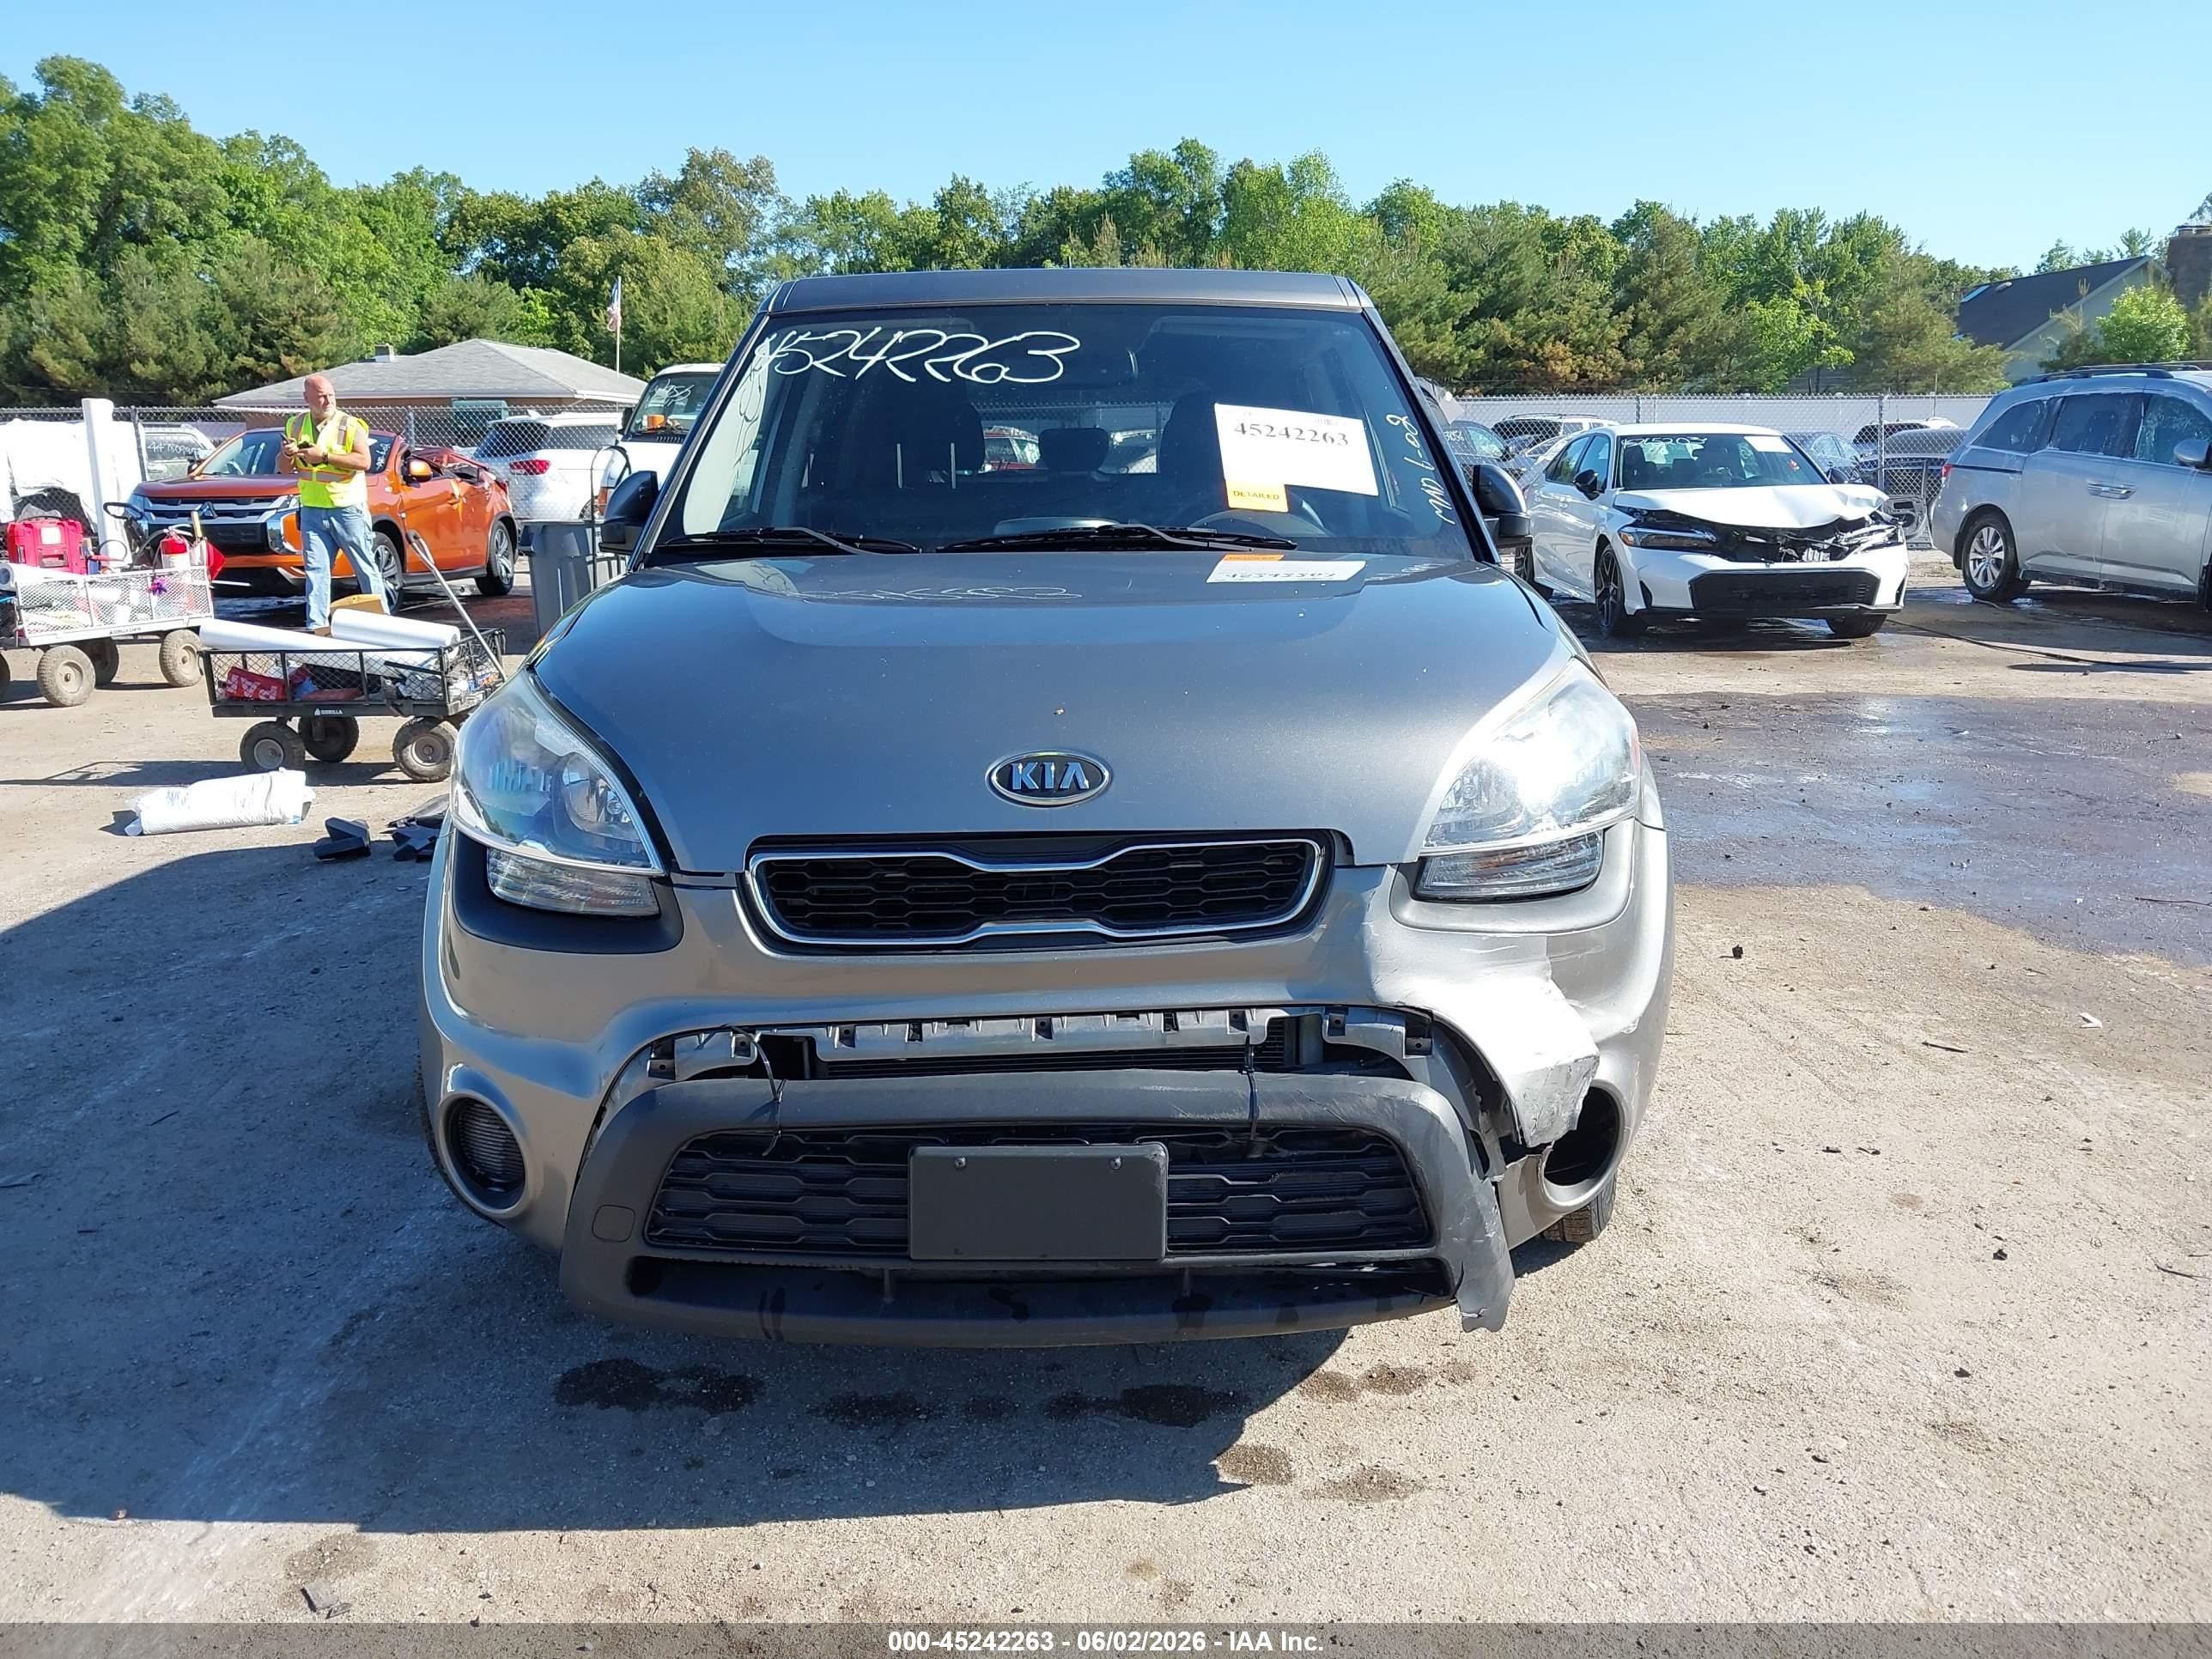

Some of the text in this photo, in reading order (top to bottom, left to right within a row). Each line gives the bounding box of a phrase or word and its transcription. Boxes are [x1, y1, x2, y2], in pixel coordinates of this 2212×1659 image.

[1234, 422, 1349, 447] 45242263
[1232, 489, 1280, 501] DETAILED
[1009, 762, 1090, 790] KIA
